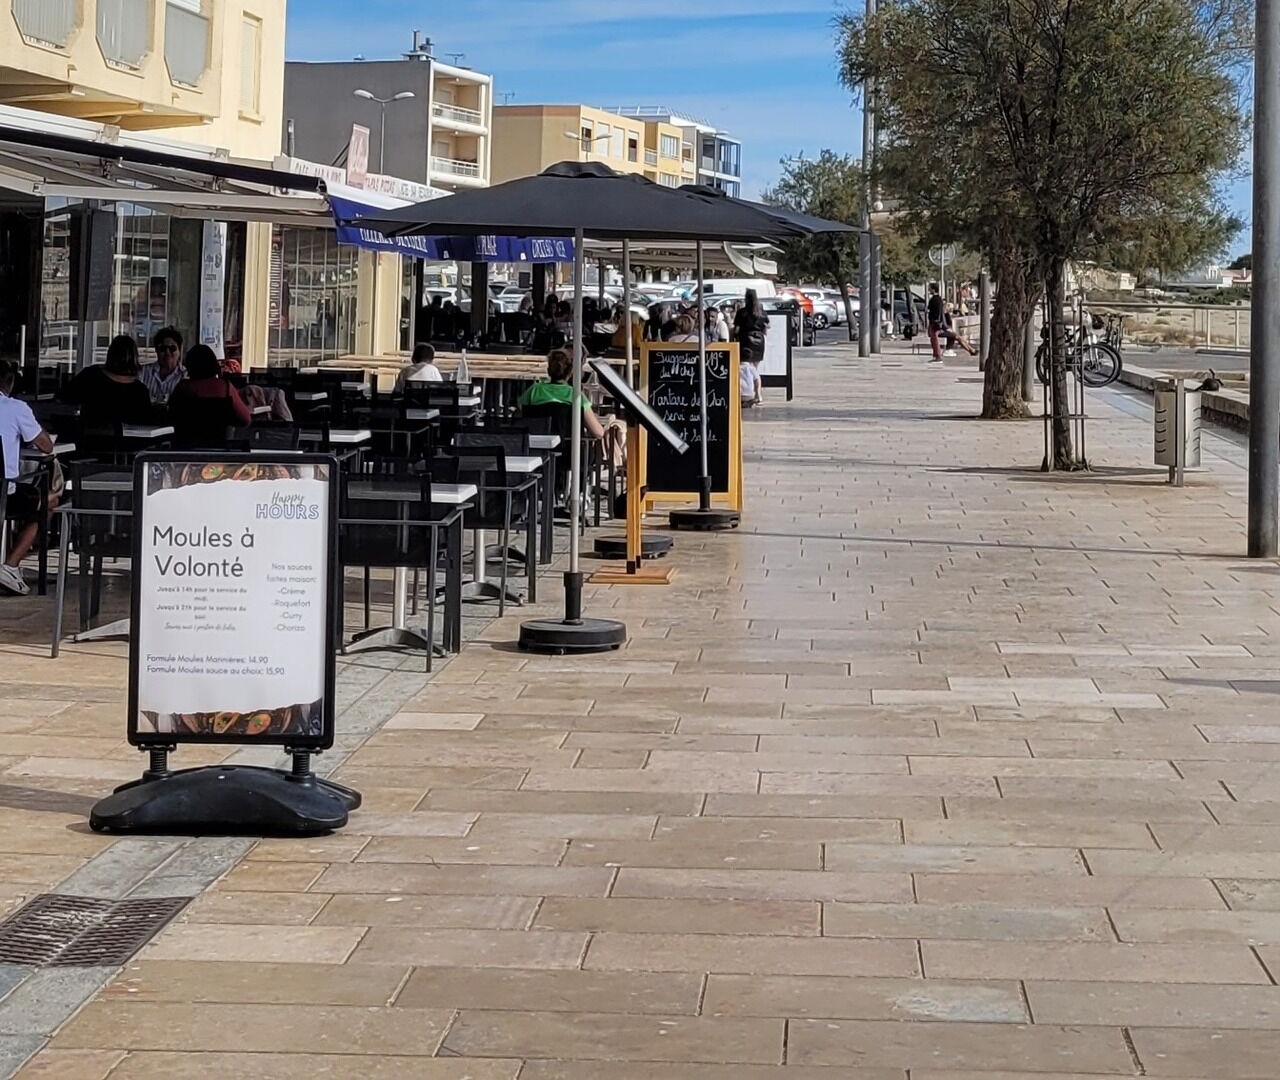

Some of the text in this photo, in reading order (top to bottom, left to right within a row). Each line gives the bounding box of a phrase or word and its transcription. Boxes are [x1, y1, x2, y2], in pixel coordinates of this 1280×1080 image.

[660, 365, 672, 379] du
[649, 383, 688, 406] Tartare
[272, 491, 305, 506] Happy
[256, 503, 319, 519] HOURS
[153, 525, 255, 548] Moules à
[154, 555, 244, 577] Volonté
[272, 563, 285, 571] Nos
[146, 653, 176, 663] Formule
[178, 654, 204, 663] Moules
[146, 665, 176, 673] Formule
[178, 665, 204, 674] Moules
[206, 667, 228, 675] sauce
